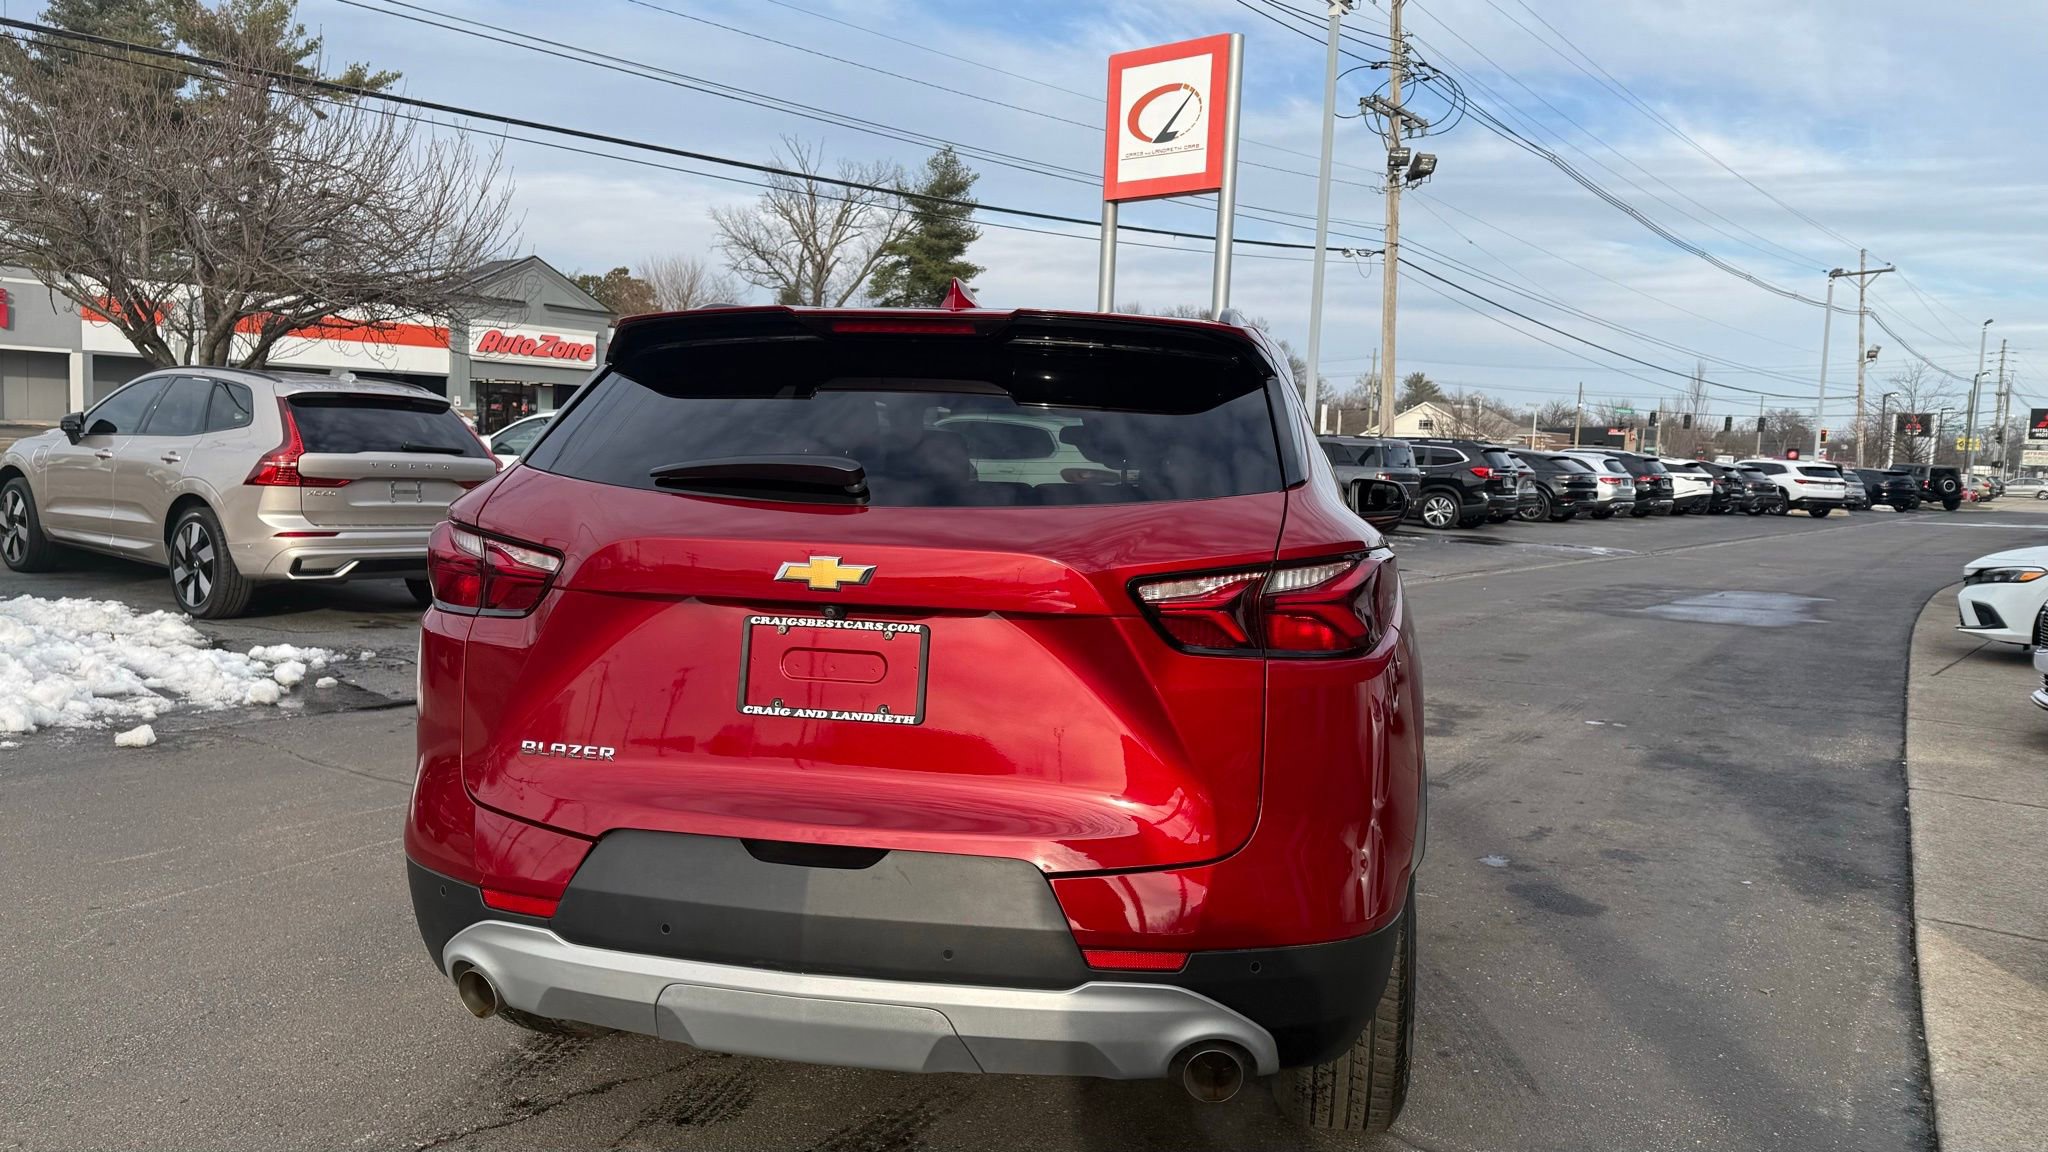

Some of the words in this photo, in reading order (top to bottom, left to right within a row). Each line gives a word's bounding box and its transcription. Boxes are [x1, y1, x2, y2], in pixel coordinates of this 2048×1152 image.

[477, 329, 595, 361] AutoZone
[750, 616, 921, 633] CRAIGSBESTCARS.COM
[742, 705, 791, 716] CRAIG
[794, 708, 827, 719] AND
[830, 711, 916, 725] LANDRETH
[521, 740, 615, 762] BLAZER
